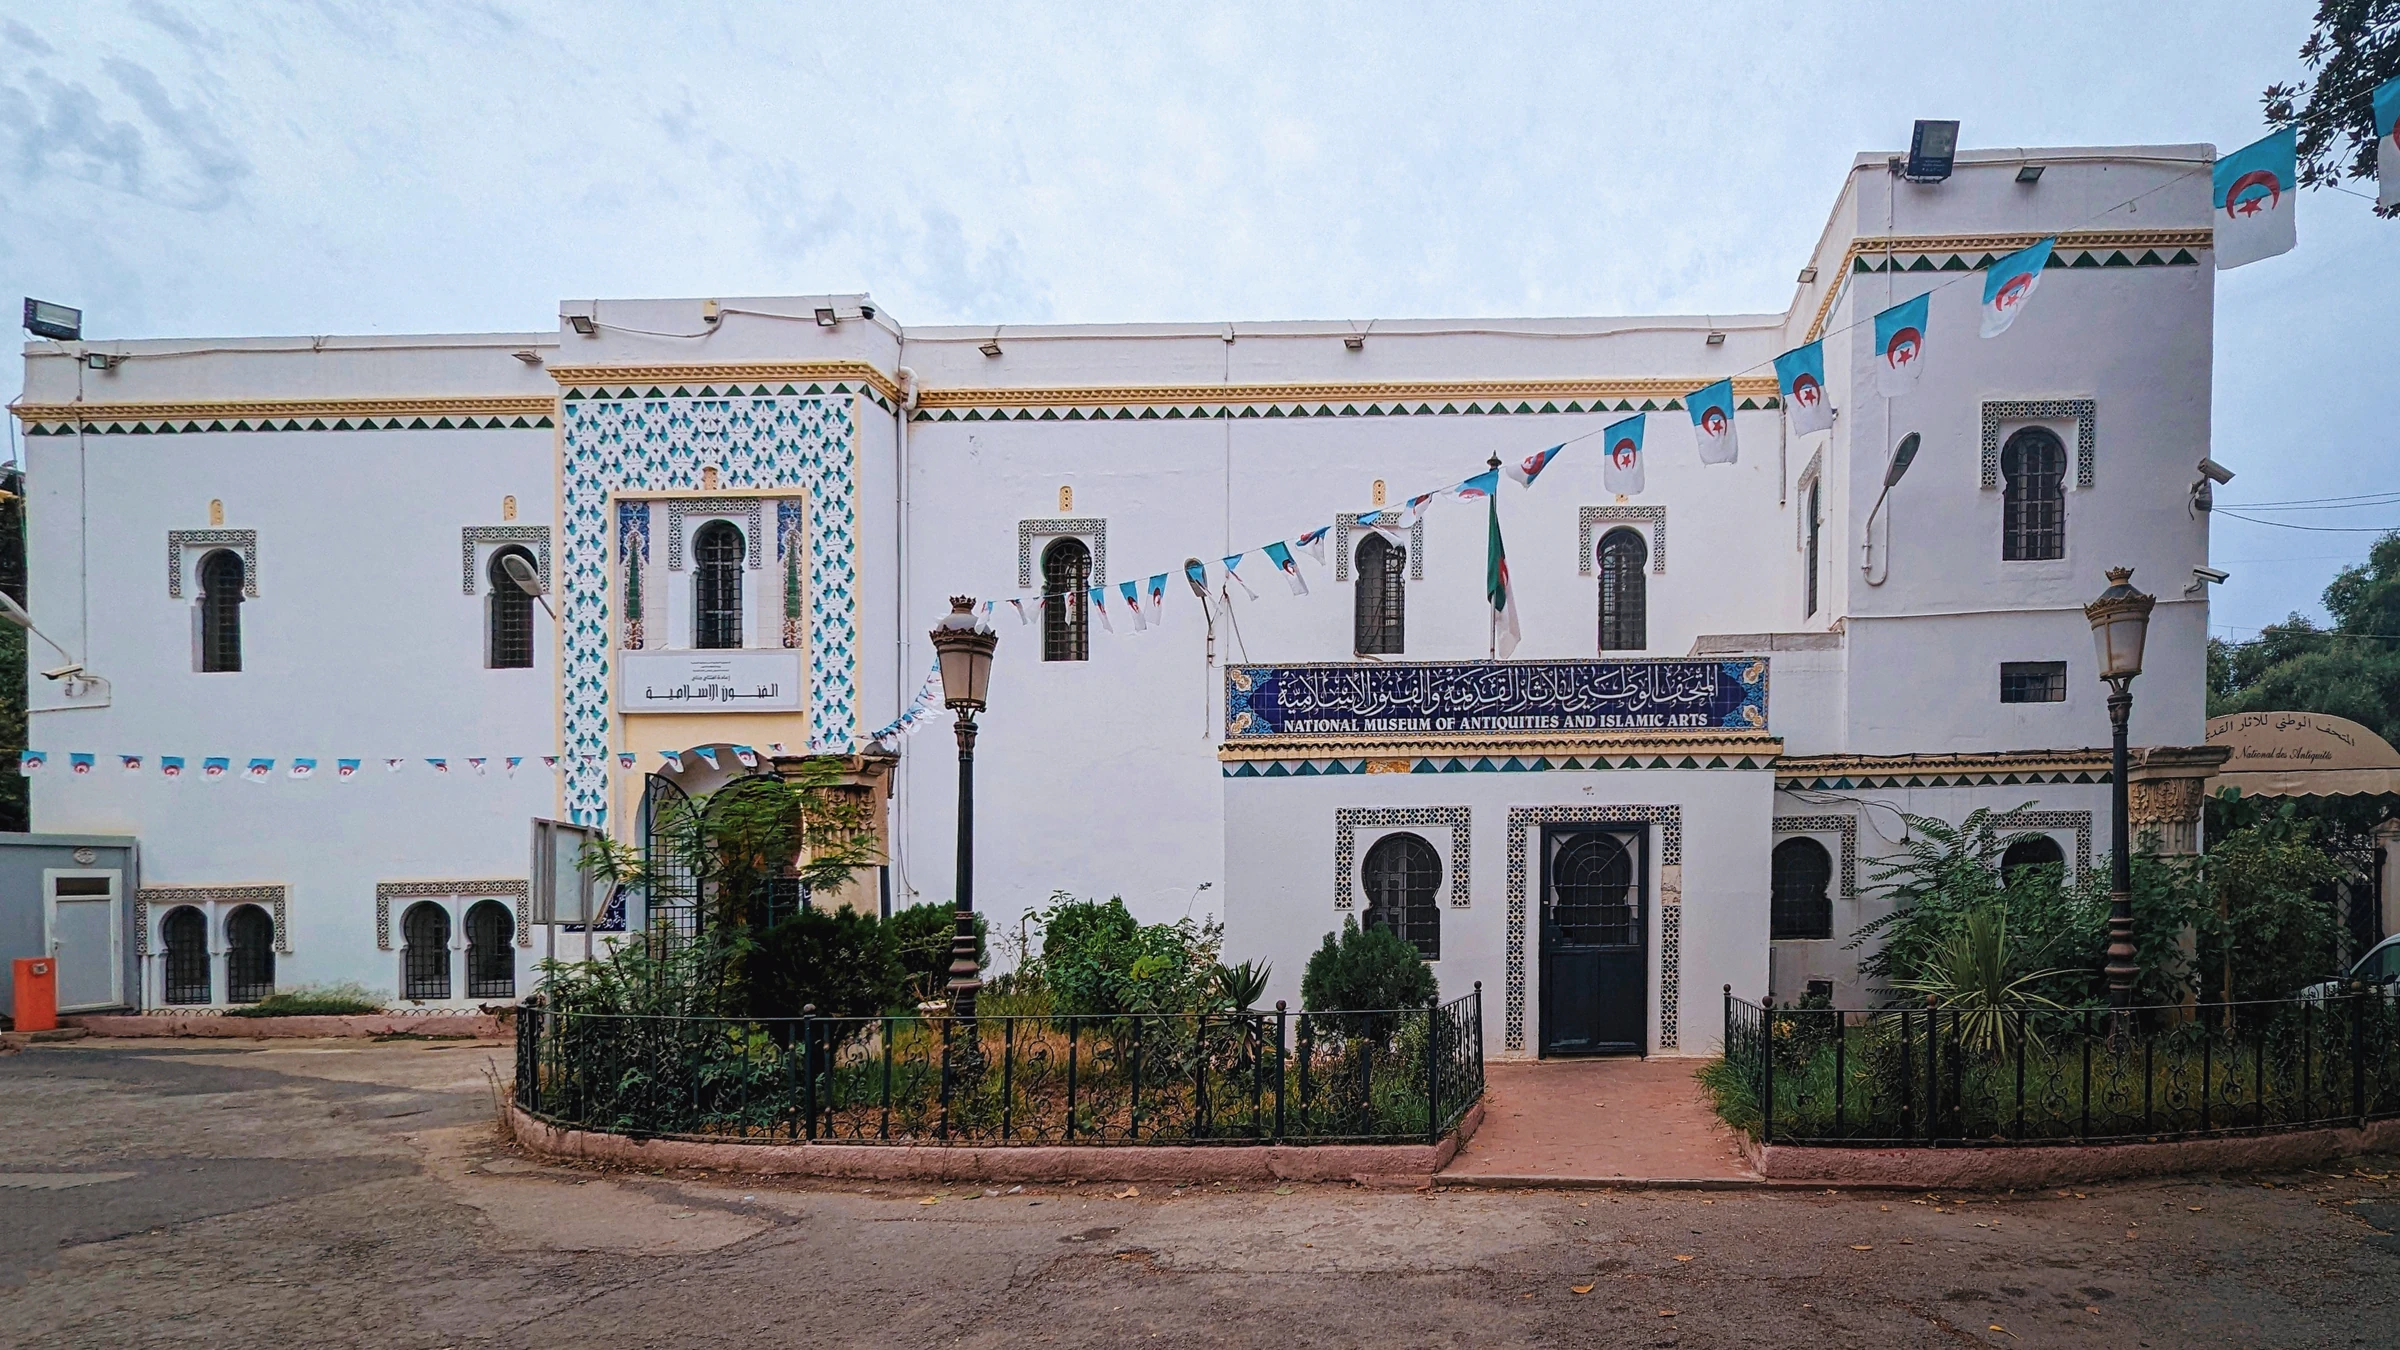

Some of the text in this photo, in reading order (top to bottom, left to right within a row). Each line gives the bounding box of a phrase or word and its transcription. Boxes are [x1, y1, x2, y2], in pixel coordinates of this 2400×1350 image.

[720, 683, 778, 702] الفنون
[1283, 713, 1708, 733] NATIONAL MUSEUM OF ANTIQUITIES AND ISLAMIC ARTS
[2275, 713, 2311, 732] الوطني
[2315, 723, 2355, 746] المتحف
[2235, 746, 2276, 759] National
[2276, 747, 2288, 759] des
